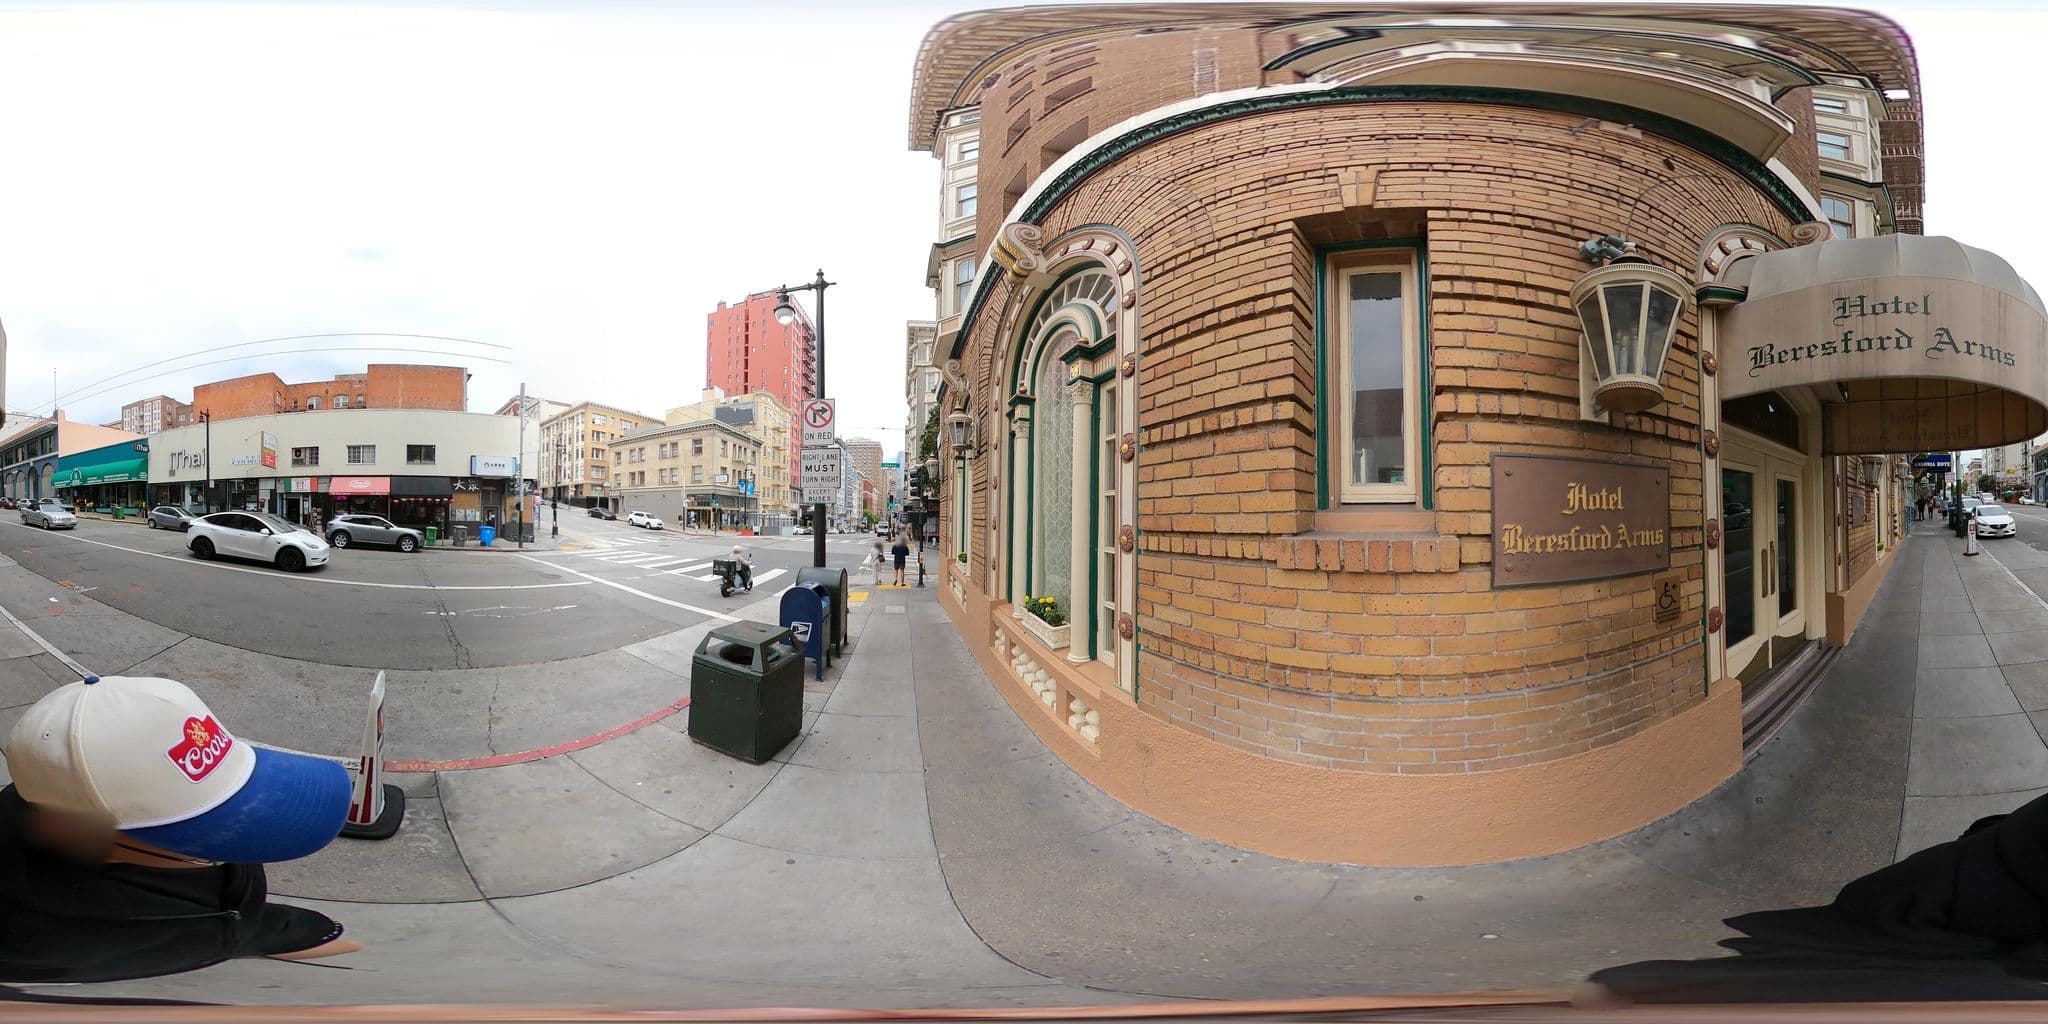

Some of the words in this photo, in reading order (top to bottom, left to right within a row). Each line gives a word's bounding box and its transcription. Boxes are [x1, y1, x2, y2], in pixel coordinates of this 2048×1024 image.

[1832, 294, 1931, 326] Hotel
[1748, 327, 1914, 377] Beresford
[1925, 326, 2016, 367] Arms
[805, 432, 815, 440] ON
[818, 431, 832, 440] RED
[805, 464, 836, 472] MUST
[820, 475, 839, 483] RIGHT
[1560, 481, 1625, 515] Hotel
[1502, 522, 1612, 555] Beresford
[1614, 523, 1664, 549] Arms
[178, 727, 229, 775] Coors
